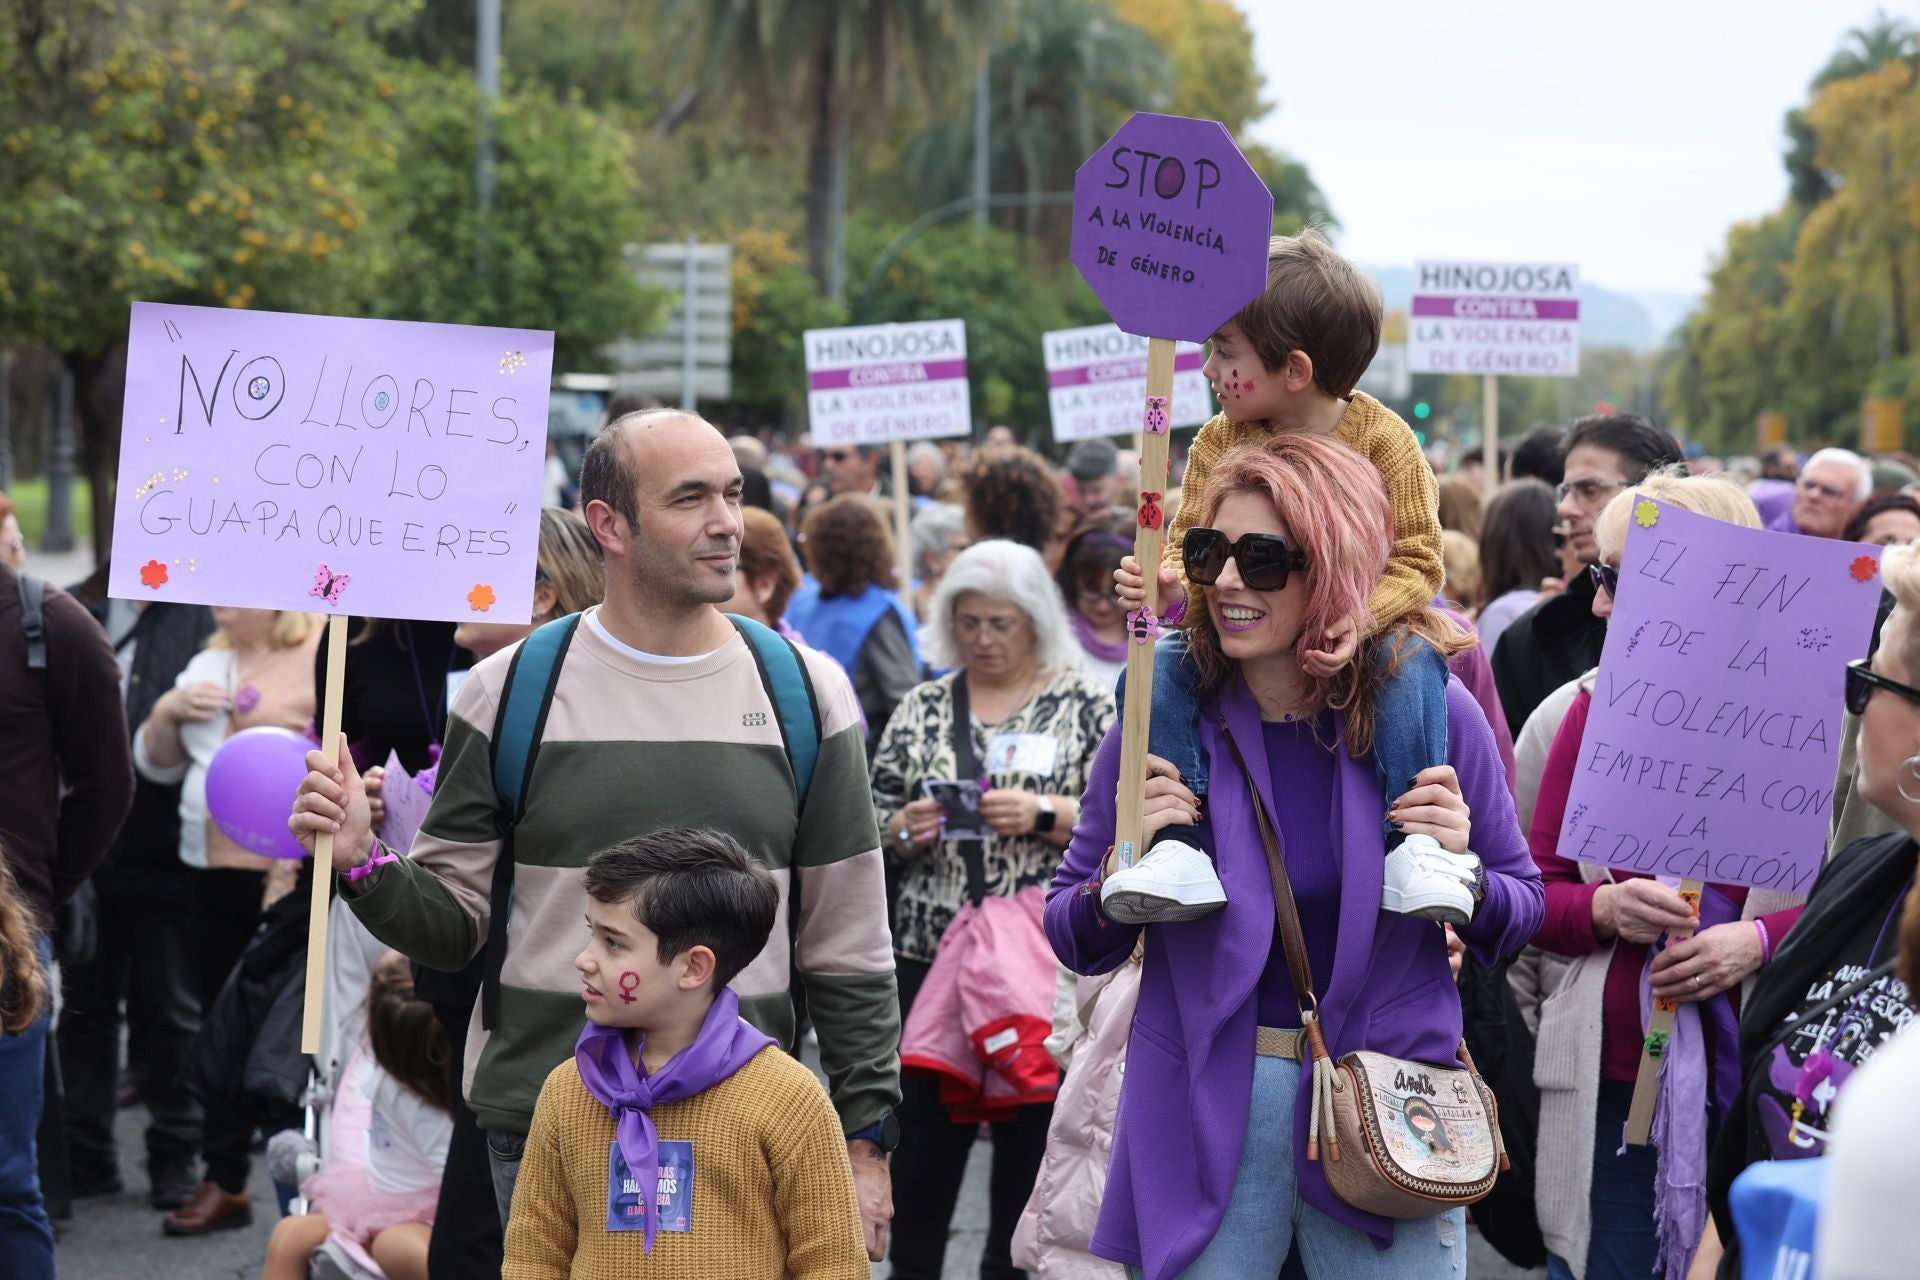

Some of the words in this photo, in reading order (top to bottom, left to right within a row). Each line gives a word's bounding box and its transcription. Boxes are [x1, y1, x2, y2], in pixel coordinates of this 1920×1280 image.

[1105, 147, 1221, 209] STOP
[1088, 205, 1104, 227] A
[1112, 209, 1131, 230] LA
[1097, 246, 1118, 266] DE
[1130, 254, 1195, 284] GÉNERO
[1420, 265, 1573, 292] HINOJOSA
[1453, 298, 1538, 319] CONTRA
[815, 329, 957, 362] HINOJOSA
[1416, 324, 1445, 342] LA
[1450, 326, 1572, 344] VIOLENCIA
[1429, 350, 1457, 368] DE
[848, 363, 929, 387] CONTRA
[817, 399, 844, 416] LA
[851, 387, 961, 411] VIOLENCIA
[1058, 395, 1084, 412] LA
[831, 419, 856, 439] DE
[254, 444, 363, 489] CON
[388, 449, 447, 501] LO
[139, 490, 300, 542] GUAPA
[317, 504, 383, 547] QUE
[1639, 540, 1687, 586] EL
[1713, 563, 1811, 613] FIN
[1658, 620, 1705, 655] DE
[1727, 640, 1767, 676] LA
[1609, 672, 1827, 753] VIOLENCIA
[1586, 742, 1746, 803] EMPIEZA
[1761, 780, 1832, 815] CON
[1668, 813, 1709, 840] LA
[1578, 824, 1813, 892] EDUCACIÓN
